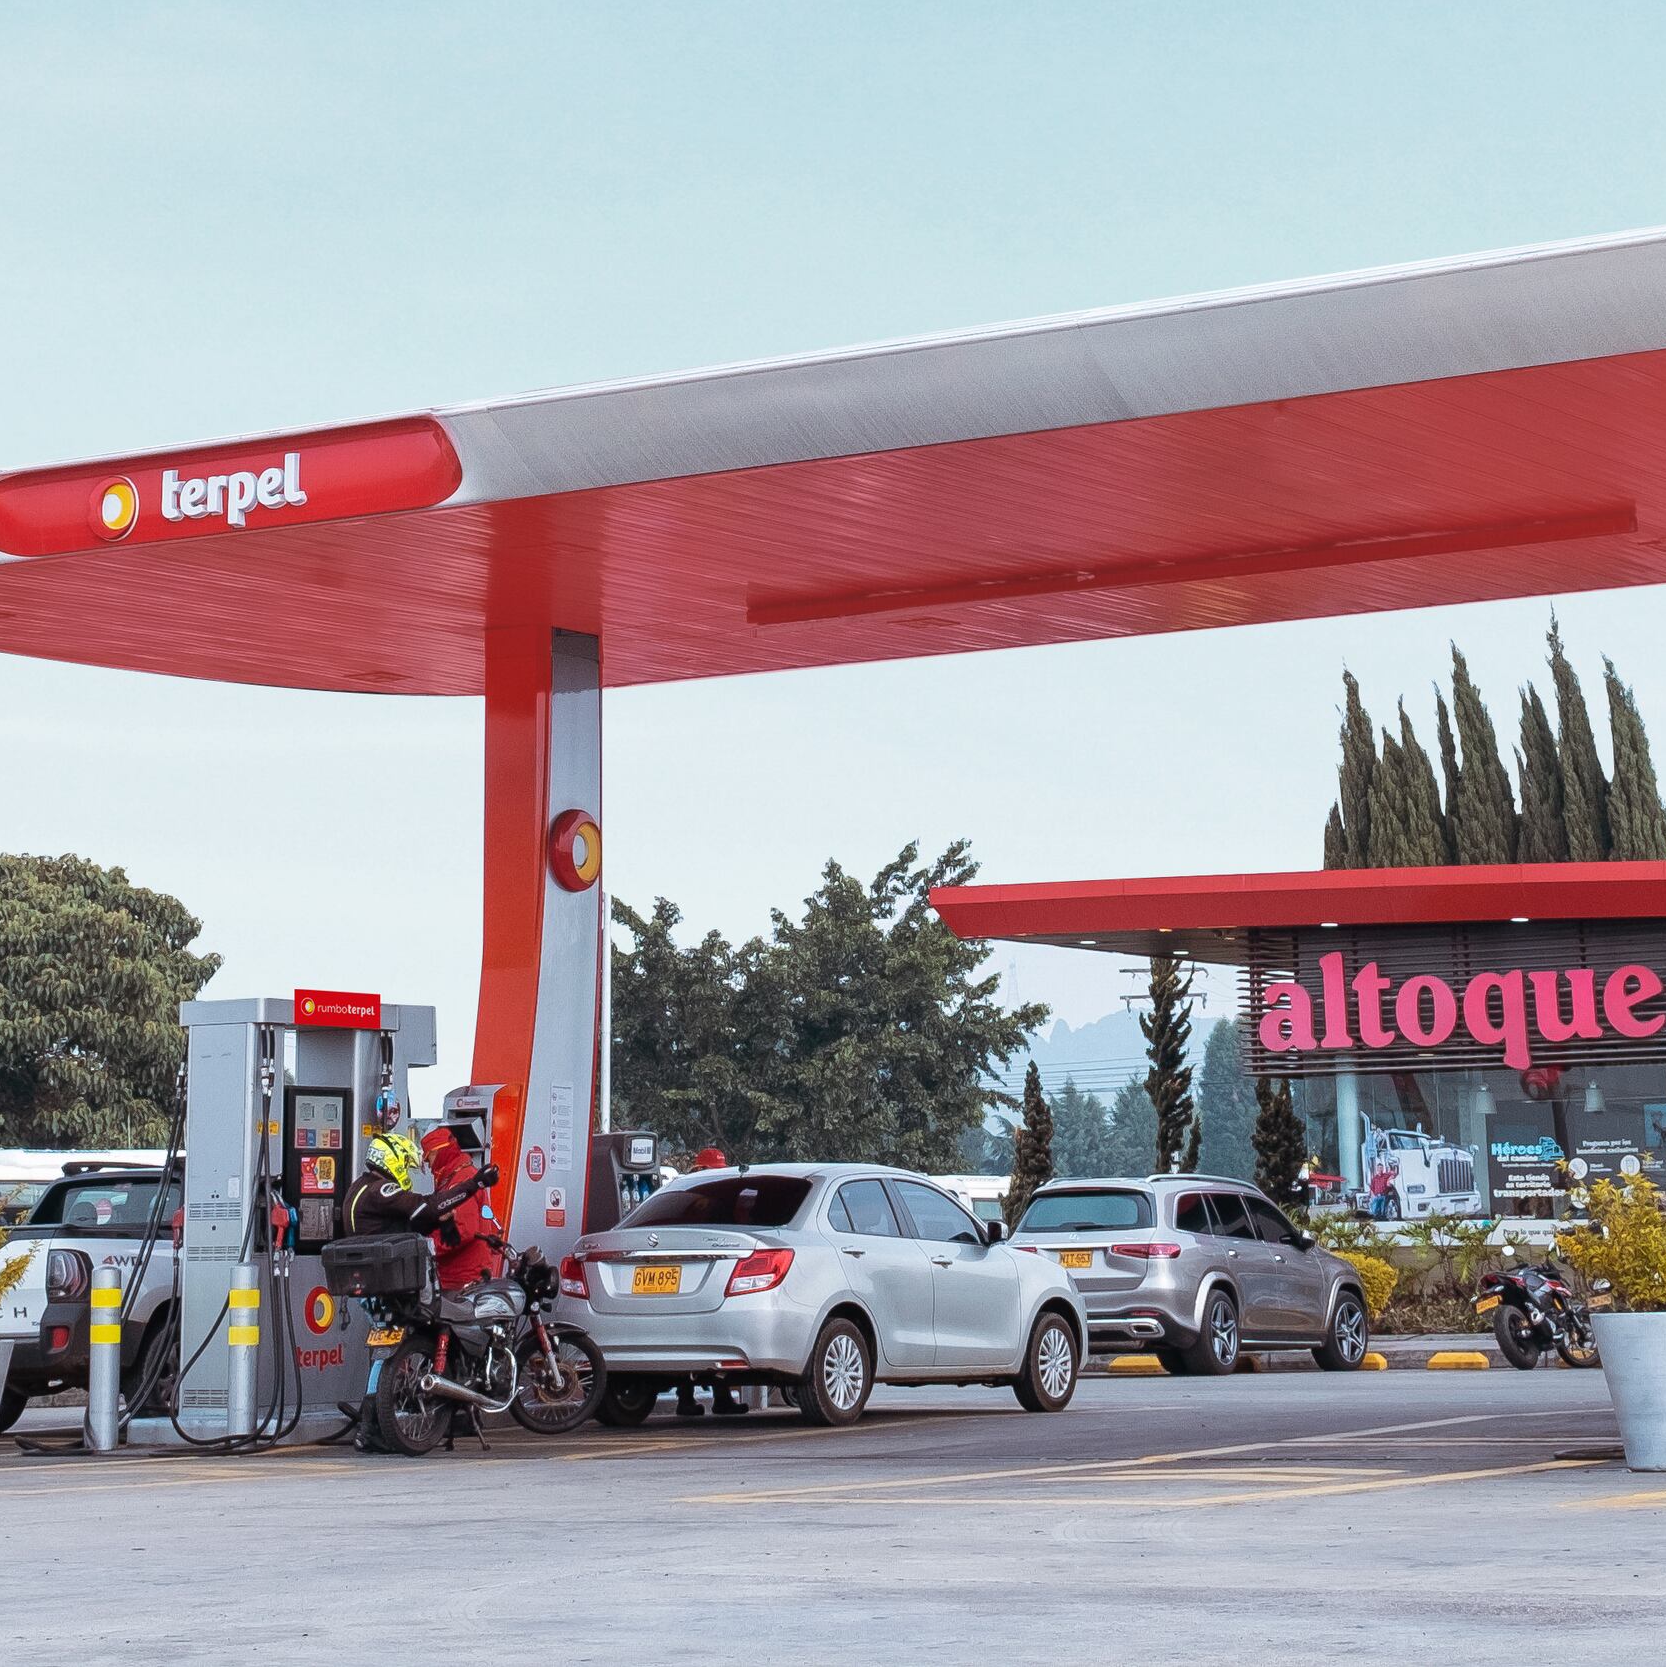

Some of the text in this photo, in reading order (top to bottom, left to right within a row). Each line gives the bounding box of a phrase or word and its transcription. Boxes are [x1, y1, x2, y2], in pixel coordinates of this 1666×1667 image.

[160, 452, 308, 527] terpel
[317, 1003, 376, 1017] rumboterpel
[1258, 951, 1666, 1070] altoque
[657, 1269, 679, 1285] 895
[296, 1343, 344, 1372] terpel
